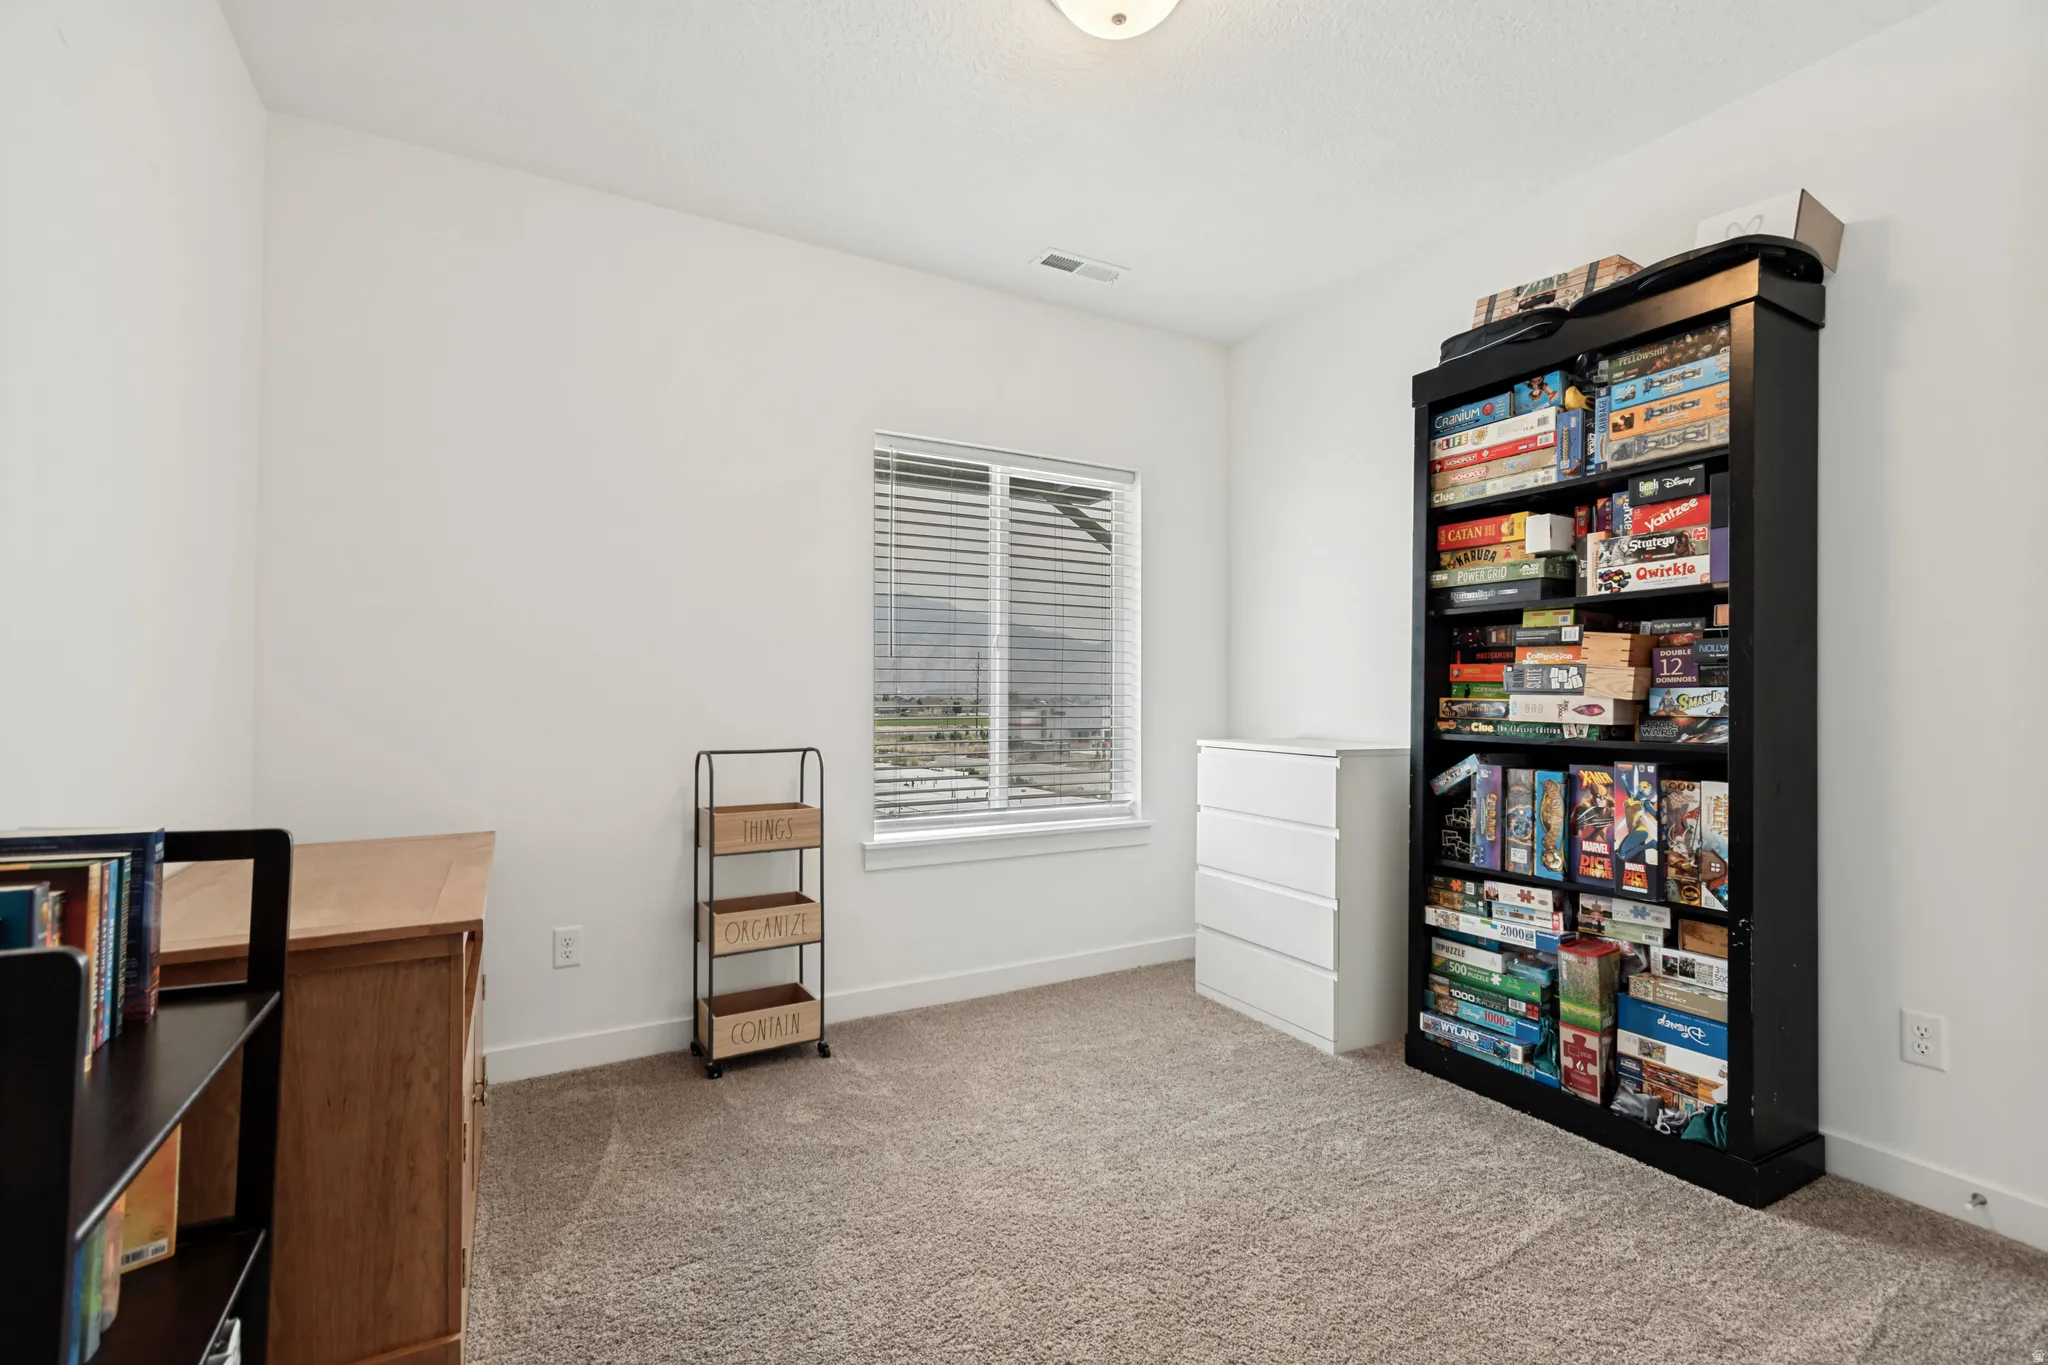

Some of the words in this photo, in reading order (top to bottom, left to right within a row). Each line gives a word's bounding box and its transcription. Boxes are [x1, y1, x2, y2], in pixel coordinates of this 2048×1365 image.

[1619, 346, 1668, 367] FELLOWSHIP
[1598, 399, 1607, 433] CRIBBAGE
[1442, 433, 1468, 450] LIFE
[1445, 453, 1477, 466] MONOPOLY
[1451, 467, 1486, 482] MONOPOLY
[1662, 476, 1695, 489] Disney
[1433, 492, 1455, 503] Clue
[1644, 498, 1698, 532] Yahtzee
[1448, 525, 1482, 542] CATAN
[1627, 536, 1675, 551] Stratego
[1455, 548, 1498, 567] KARUBA
[1457, 569, 1485, 583] POWER
[1488, 566, 1507, 580] GRID
[1636, 562, 1696, 580] Qwirkle
[1450, 588, 1496, 602] Rummikub
[1476, 651, 1514, 660] MASTERMIND
[1526, 652, 1573, 661] Commotion
[1660, 649, 1692, 657] DOUBLE
[1660, 658, 1683, 676] 12
[1526, 668, 1542, 689] SLATE
[1656, 675, 1697, 684] DOMINOES
[1471, 722, 1494, 733] Clue
[1510, 725, 1532, 733] Classic
[1535, 726, 1561, 734] Edition
[1641, 728, 1678, 737] WARS
[1578, 770, 1614, 788] X-MEN
[1582, 841, 1610, 854] MARVEL
[1580, 855, 1611, 870] DICE
[1625, 862, 1645, 872] MARVEL
[1579, 866, 1613, 880] THRONE
[1624, 871, 1647, 881] DICE
[1500, 924, 1524, 940] 2000
[1441, 944, 1466, 958] PUZZLE
[1449, 960, 1467, 976] 500
[1467, 970, 1489, 983] PUZZLE
[1450, 988, 1475, 1003] 1000
[1656, 987, 1679, 997] FLIGHT
[1666, 994, 1687, 1004] FANCY
[1484, 1010, 1506, 1027] 1000
[1441, 1021, 1480, 1042] WYLAND
[1656, 1014, 1710, 1046] Disney
